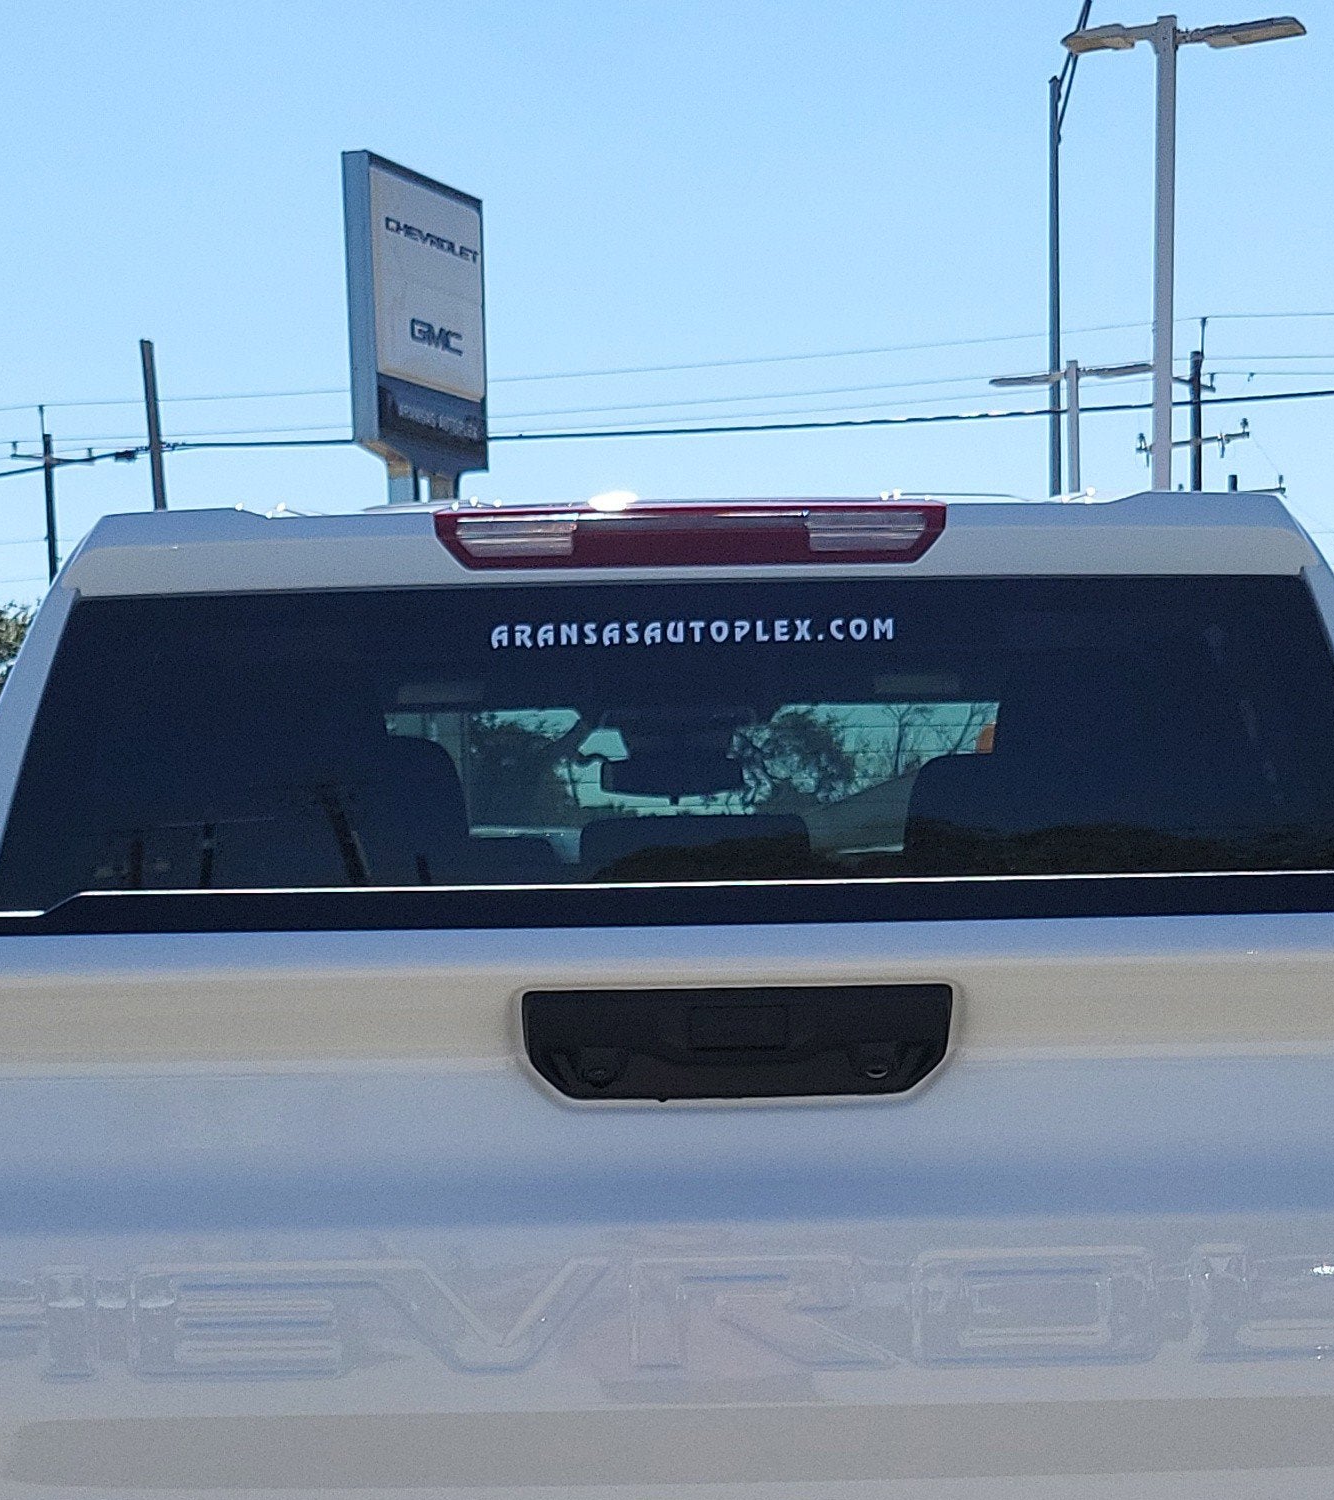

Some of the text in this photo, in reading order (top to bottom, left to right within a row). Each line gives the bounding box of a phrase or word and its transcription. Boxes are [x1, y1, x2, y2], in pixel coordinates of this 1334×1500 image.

[385, 217, 479, 264] CHEVROLET
[411, 318, 463, 356] GMC
[490, 617, 896, 649] ARANSASAUTOPLEX.COM
